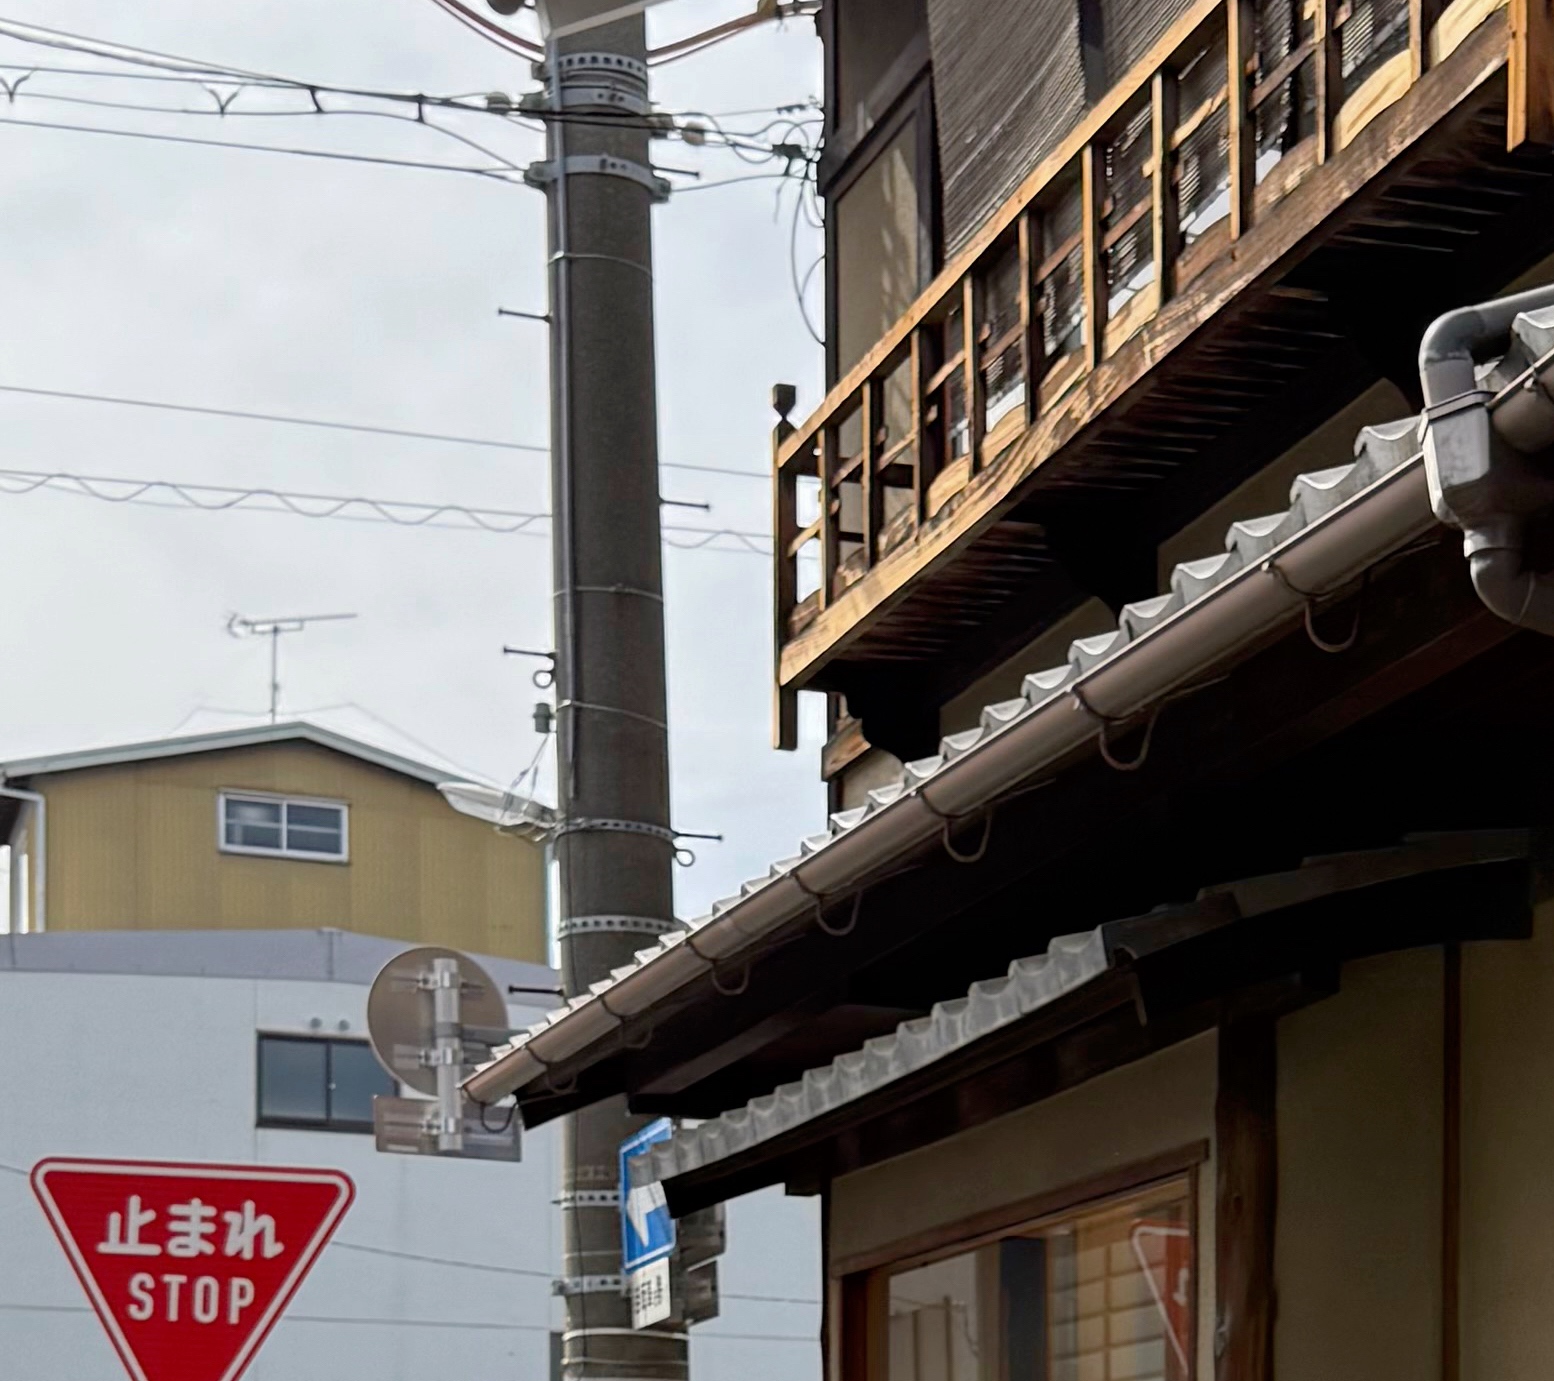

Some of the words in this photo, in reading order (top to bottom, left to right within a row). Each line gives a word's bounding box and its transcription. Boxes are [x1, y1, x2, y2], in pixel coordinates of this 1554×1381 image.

[97, 1194, 285, 1260] 止まれ
[128, 1272, 255, 1325] STOP
